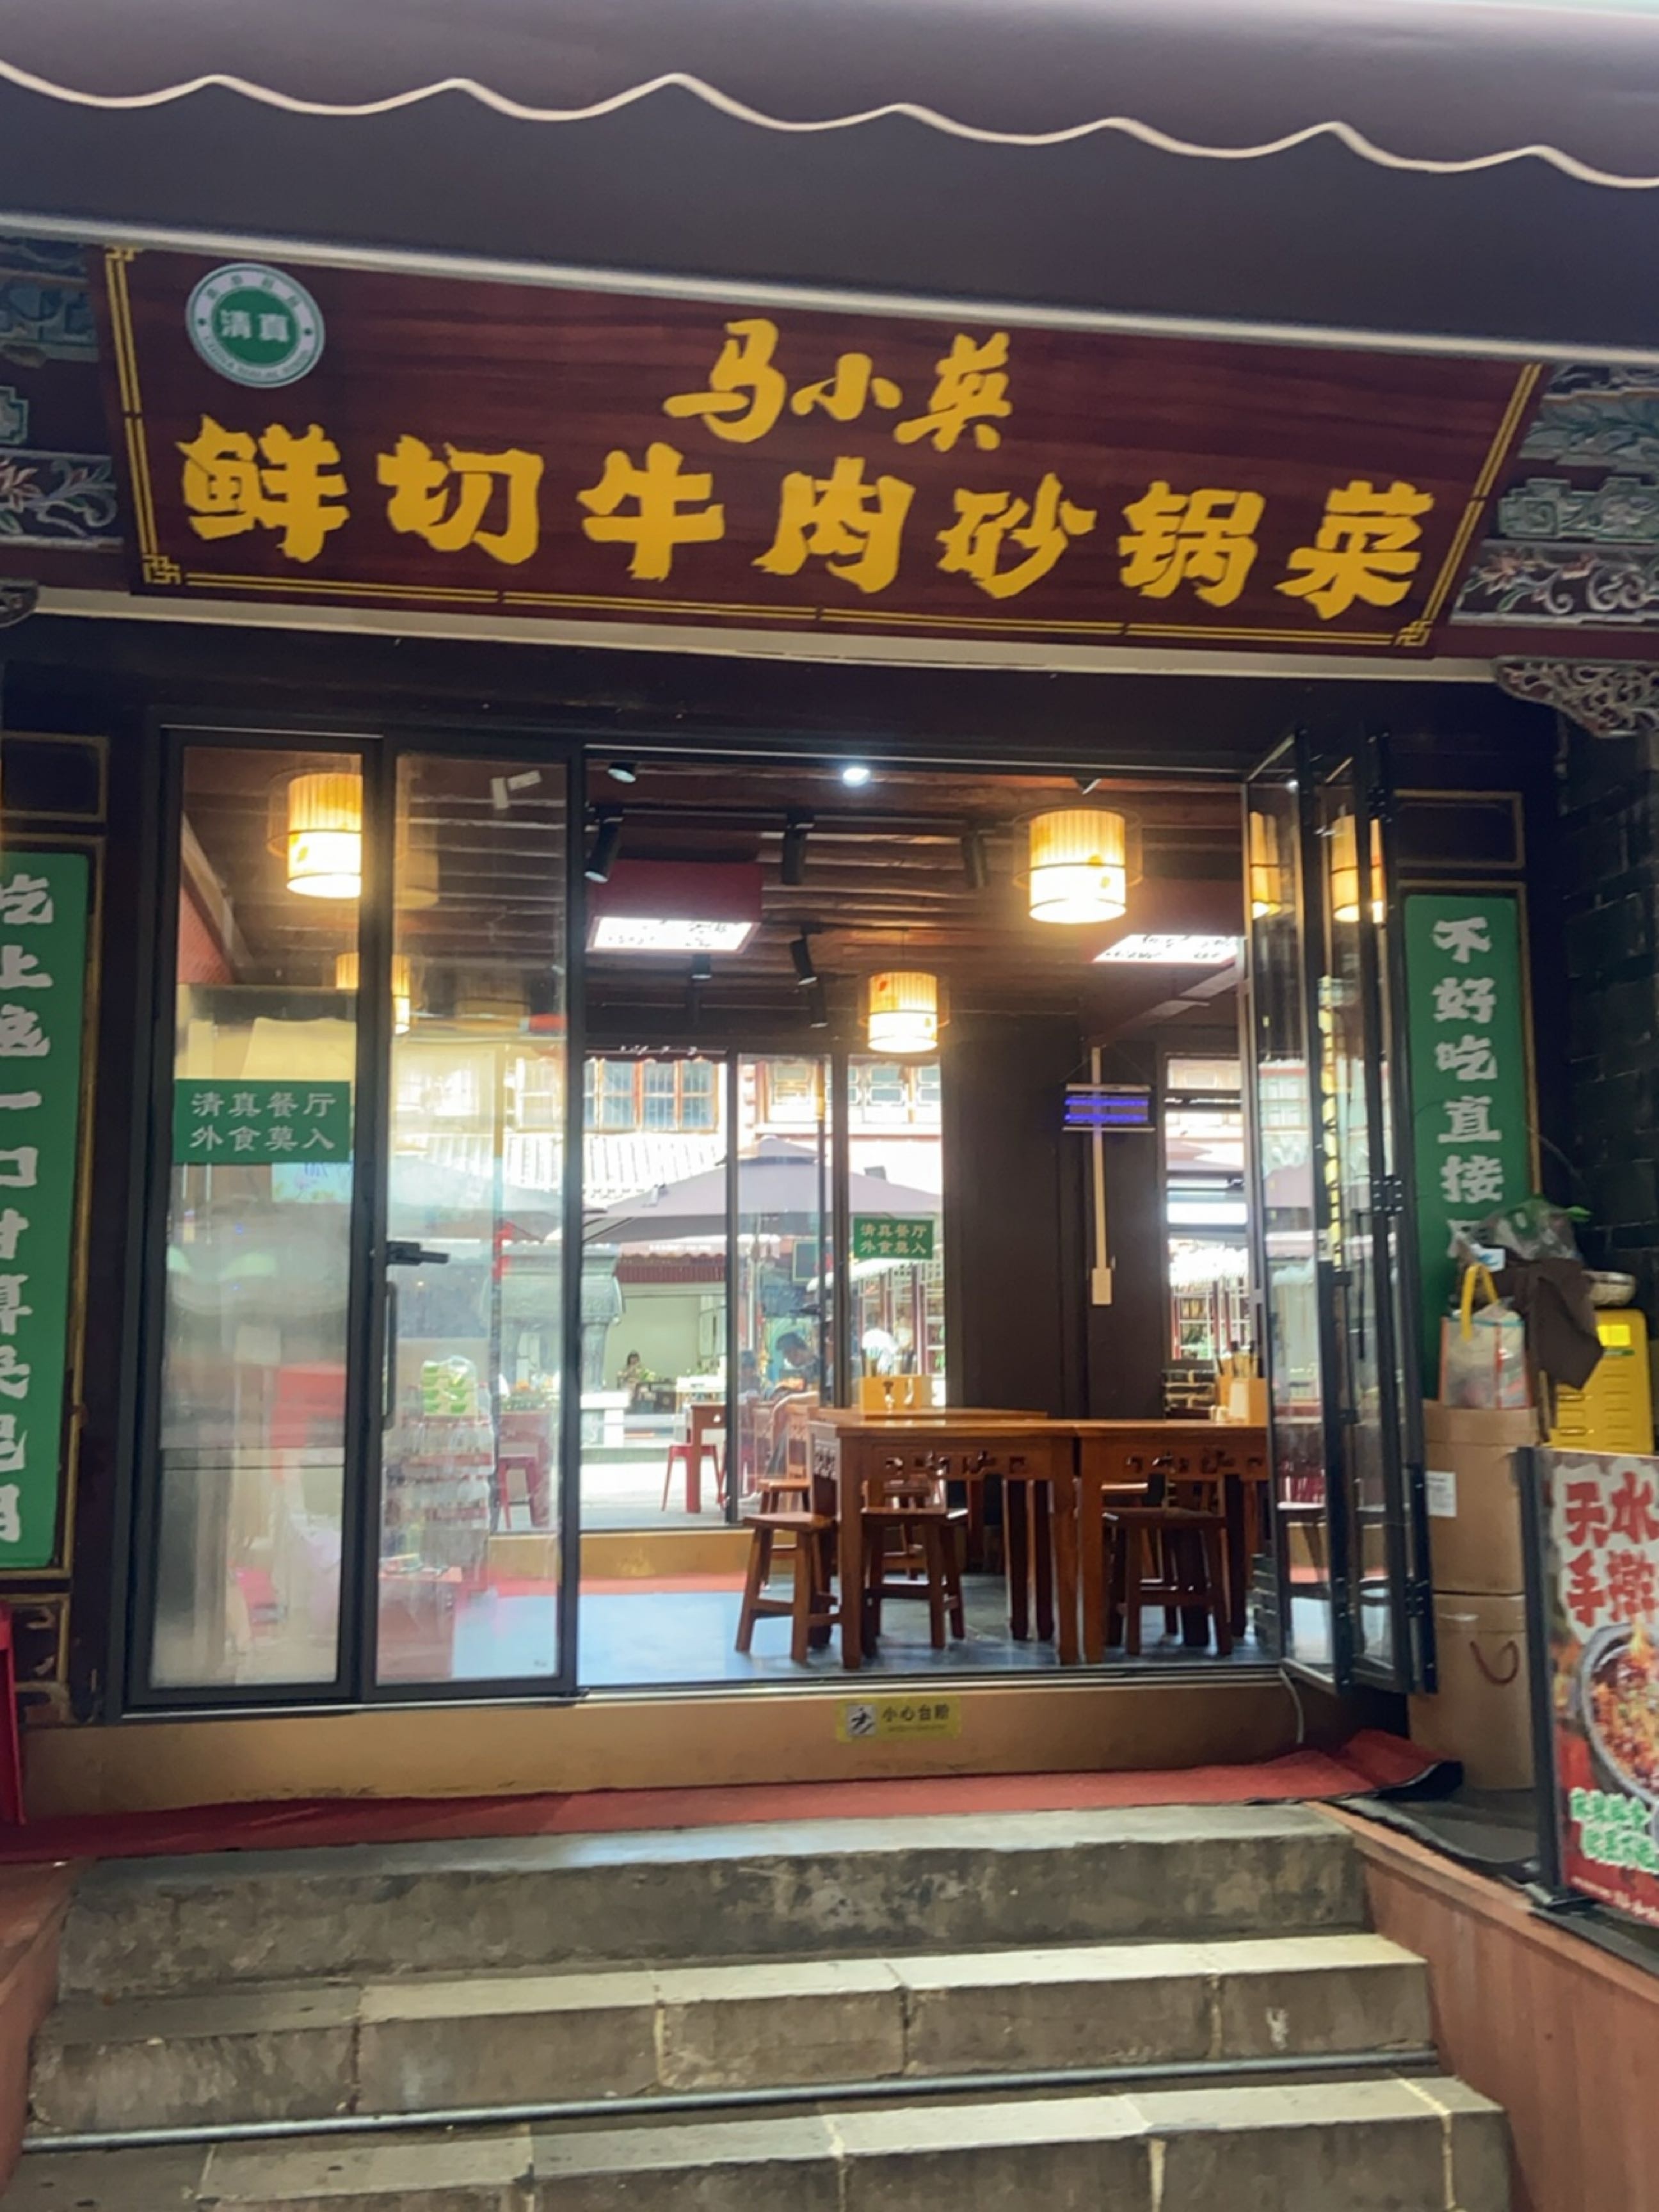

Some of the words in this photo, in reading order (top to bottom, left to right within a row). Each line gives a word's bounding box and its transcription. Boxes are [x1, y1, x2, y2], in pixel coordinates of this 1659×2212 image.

[663, 319, 1011, 451] 马小英
[175, 414, 1434, 620] 鲜切牛肉砂锅菜
[191, 1091, 336, 1117] 清真餐厅
[189, 1125, 335, 1151] 外食莫入
[860, 1223, 926, 1238] 清真餐厅
[1566, 1471, 1659, 1548] 天水
